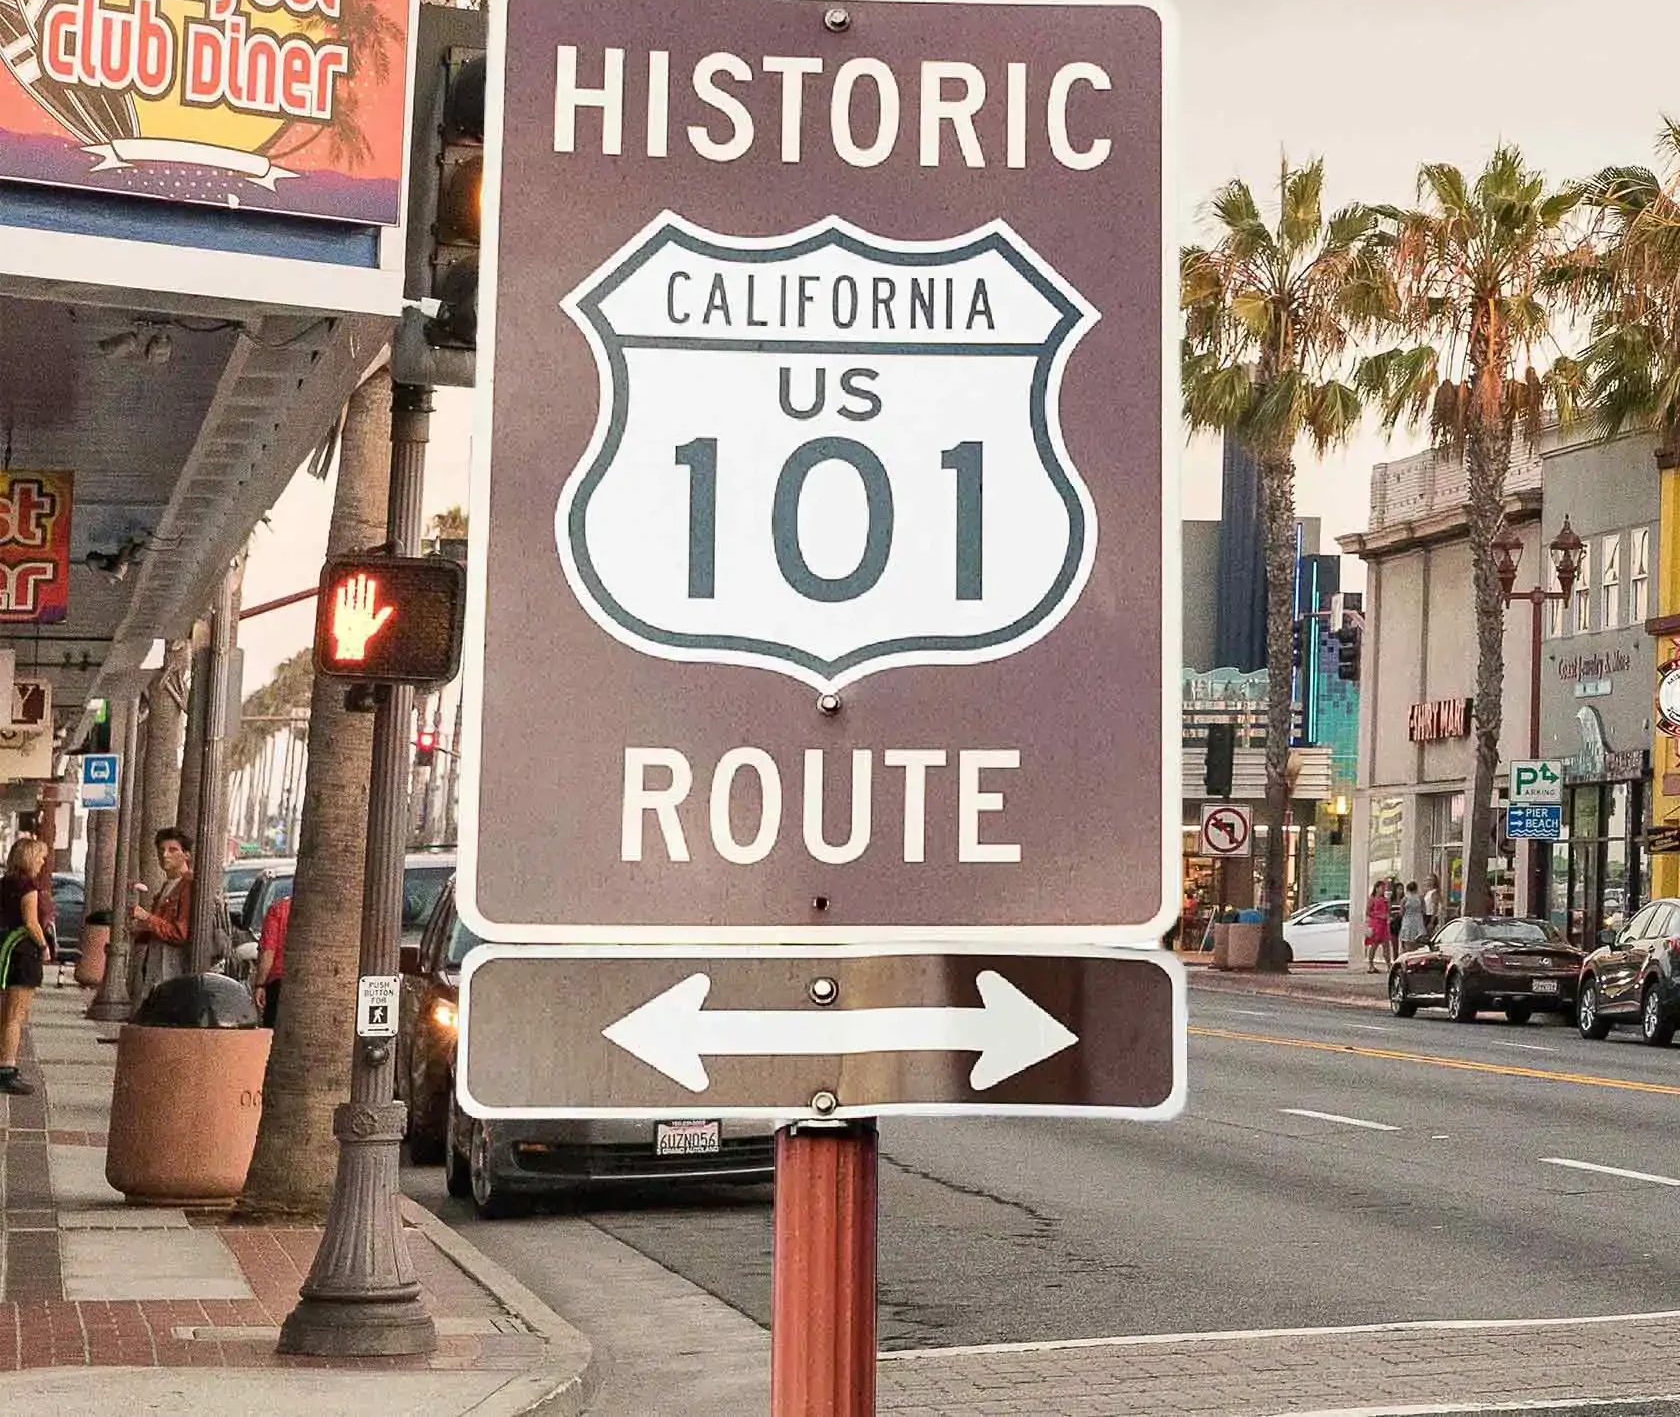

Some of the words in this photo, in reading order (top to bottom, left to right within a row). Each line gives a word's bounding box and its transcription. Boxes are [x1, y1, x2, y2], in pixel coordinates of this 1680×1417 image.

[186, 16, 349, 120] Diner
[554, 45, 1113, 171] HISTORIC
[666, 270, 996, 331] CALIFORNIA
[777, 367, 883, 421] US
[675, 435, 984, 603] 101
[620, 746, 1022, 865] ROUTE
[1525, 808, 1548, 818] PIER
[1525, 818, 1559, 828] BEACH
[660, 1132, 717, 1149] 6UZN056
